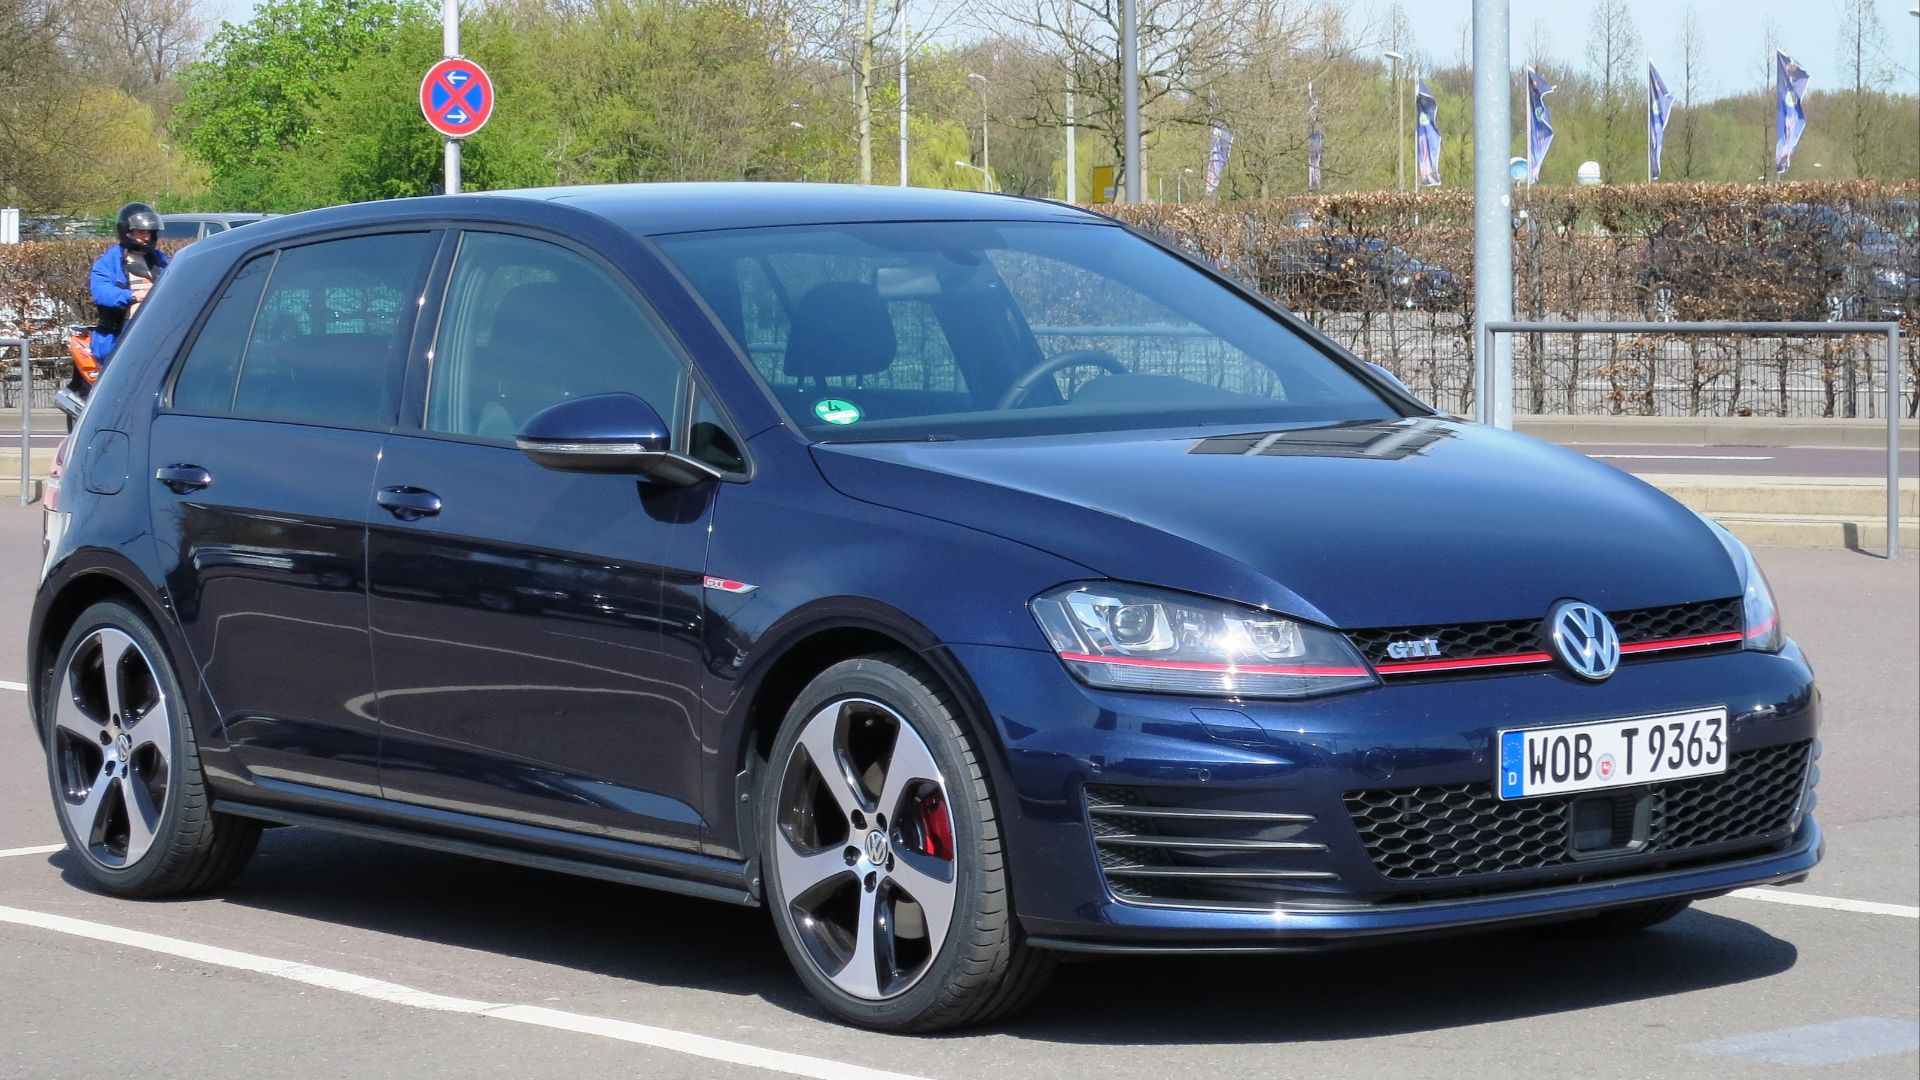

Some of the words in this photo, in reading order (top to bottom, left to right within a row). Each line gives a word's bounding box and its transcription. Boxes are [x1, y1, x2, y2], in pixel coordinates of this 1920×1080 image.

[1387, 639, 1441, 660] GTI
[1555, 602, 1620, 678] VW
[1508, 771, 1518, 786] D
[1528, 732, 1593, 786] WOB
[1620, 727, 1640, 776] T
[1649, 717, 1723, 773] 9363
